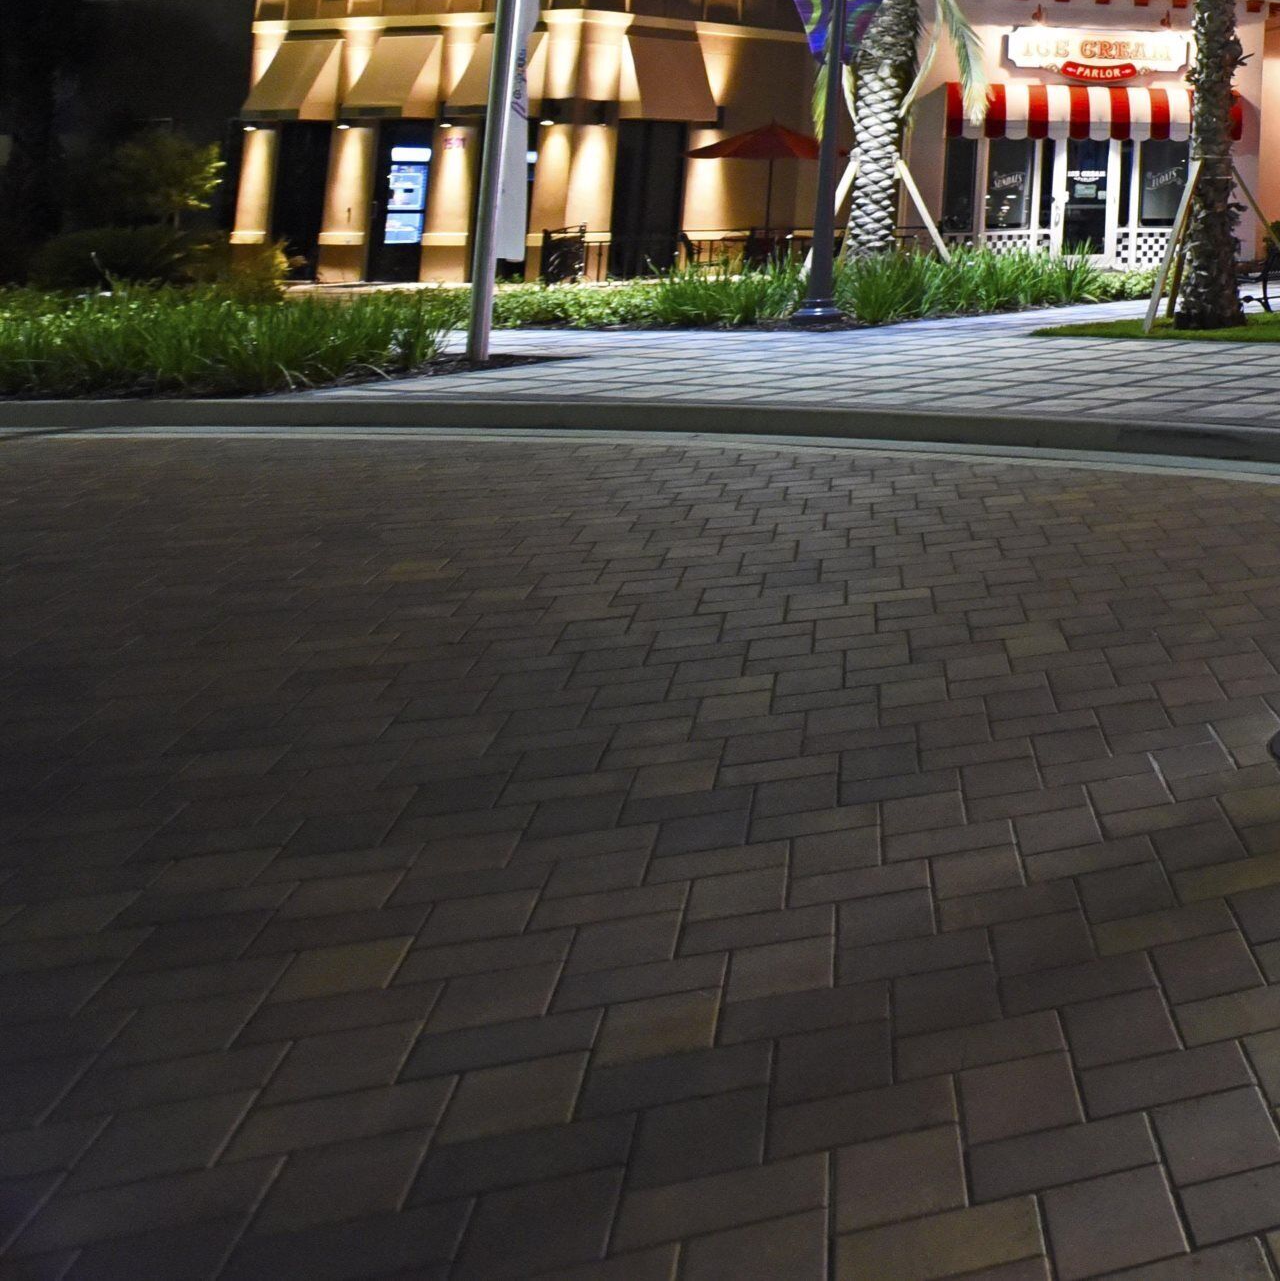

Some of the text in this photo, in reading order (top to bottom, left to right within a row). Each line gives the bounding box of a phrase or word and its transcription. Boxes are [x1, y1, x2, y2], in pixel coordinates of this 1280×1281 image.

[1022, 39, 1172, 61] ICE CREAM
[1075, 65, 1122, 79] PARLOR
